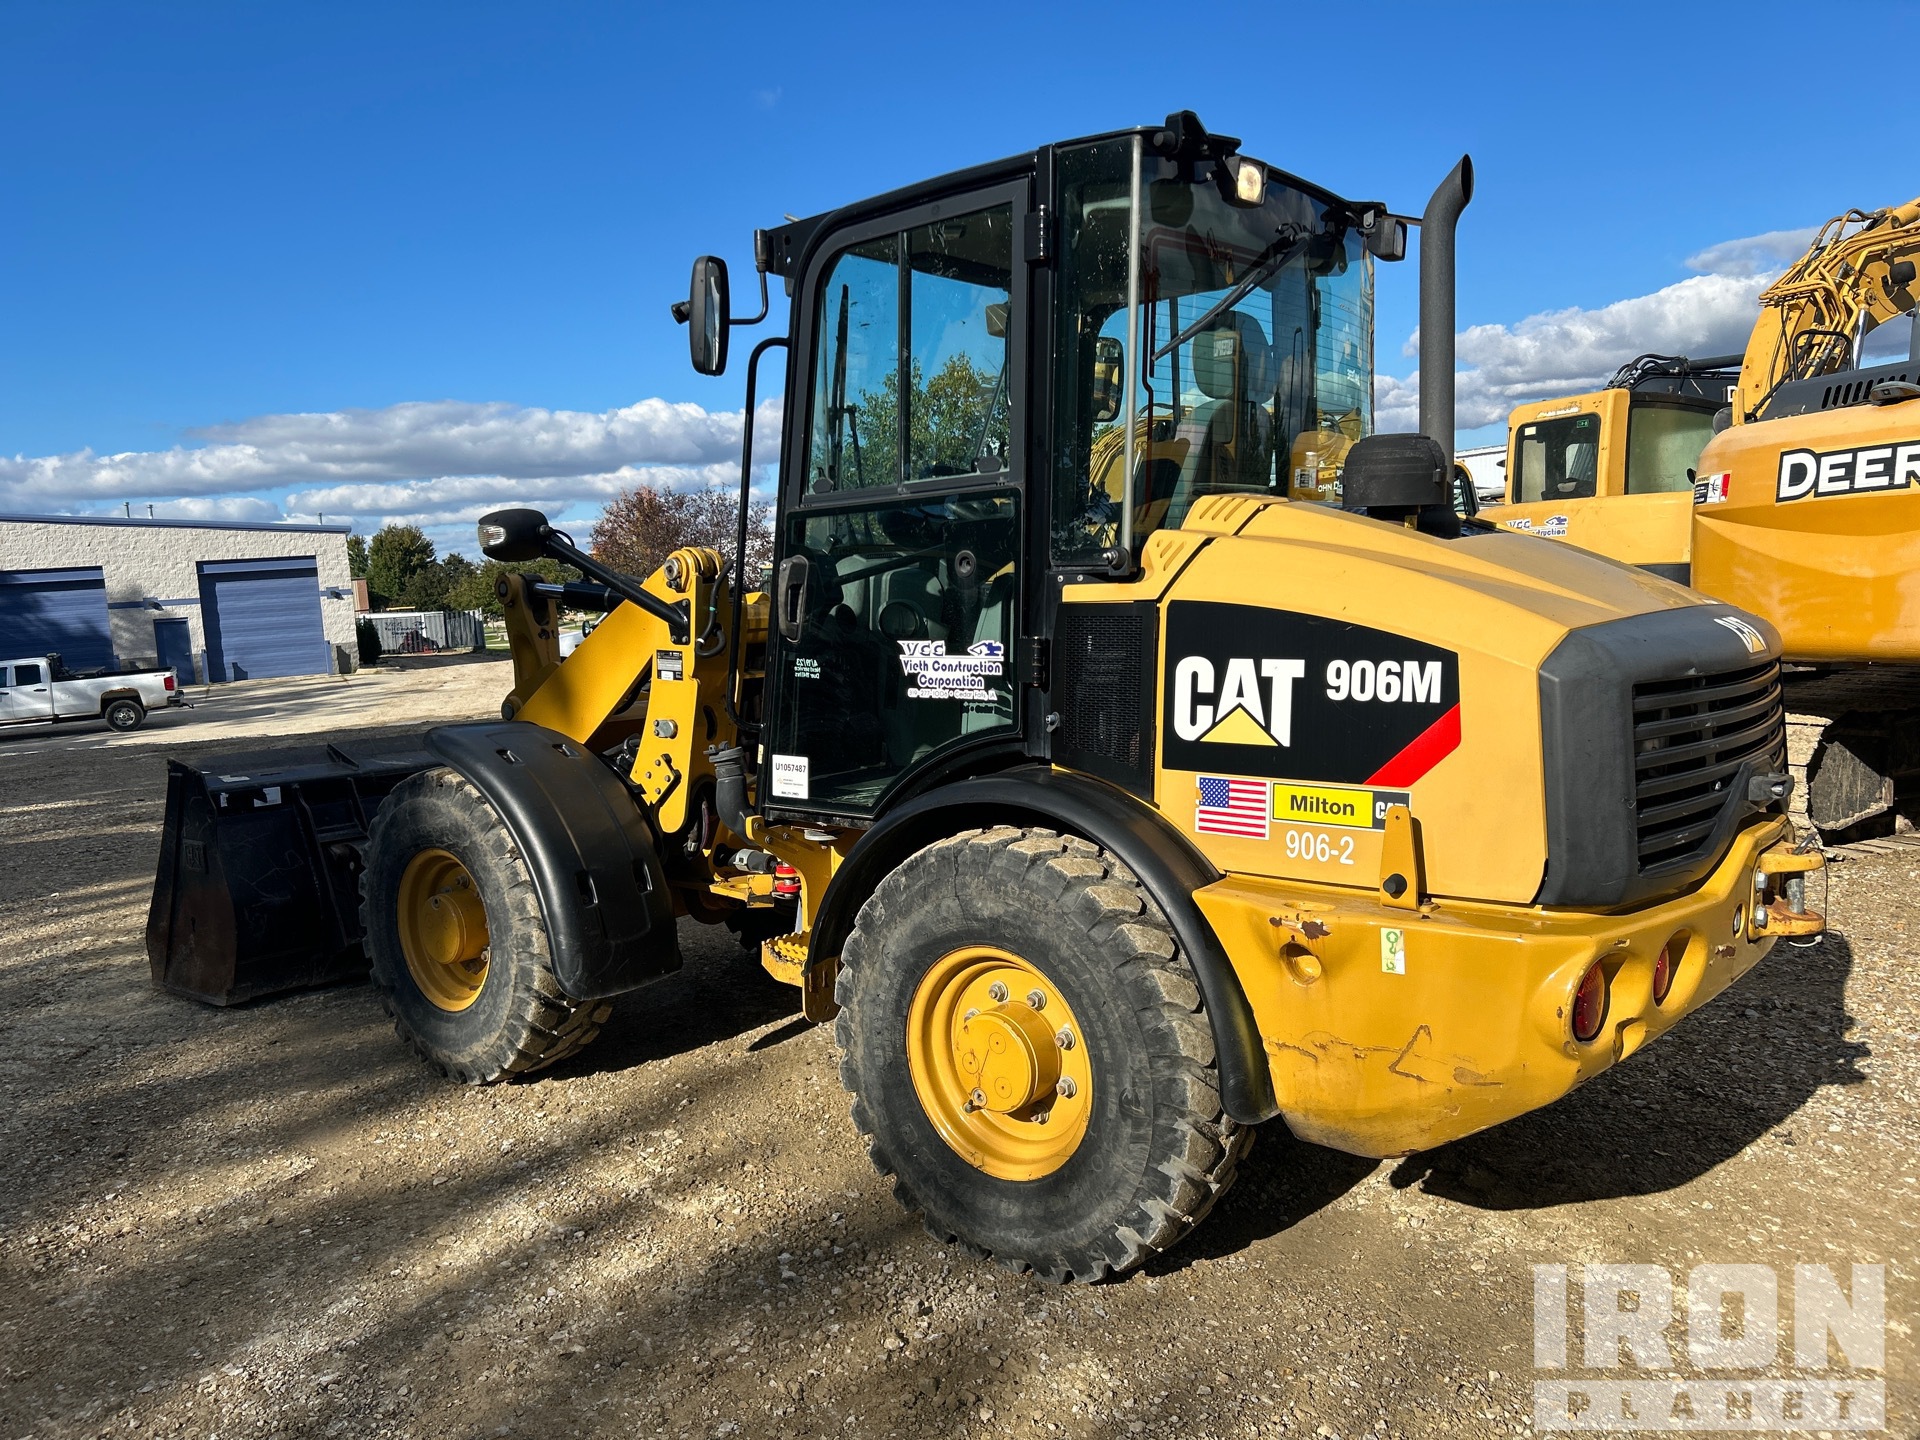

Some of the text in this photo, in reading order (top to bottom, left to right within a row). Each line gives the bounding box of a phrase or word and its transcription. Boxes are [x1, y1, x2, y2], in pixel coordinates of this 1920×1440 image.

[1318, 483, 1332, 493] OHN
[903, 660, 1001, 673] Vieth Construction
[919, 674, 983, 689] Corporation
[954, 690, 973, 698] Cedar
[1173, 655, 1443, 748] CAT 906M
[775, 762, 806, 773] U1057487
[1290, 794, 1355, 816] Milton
[1285, 829, 1355, 865] 906-2
